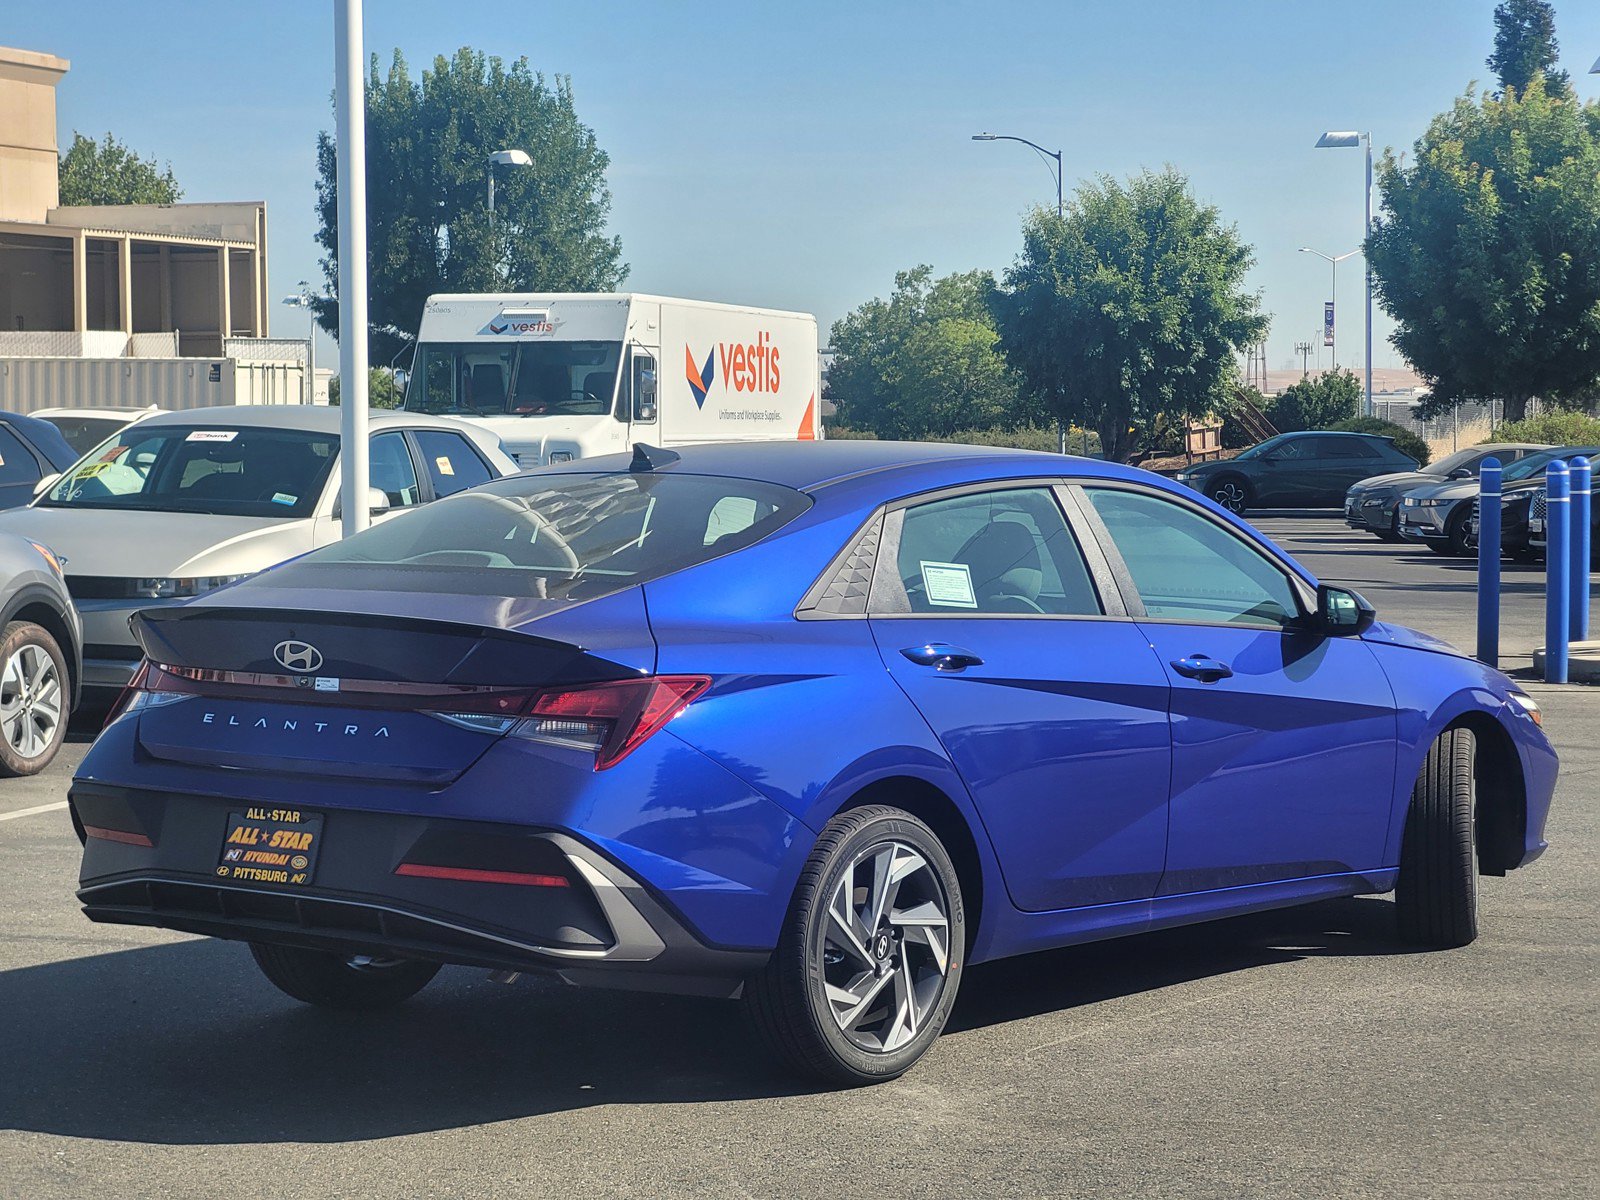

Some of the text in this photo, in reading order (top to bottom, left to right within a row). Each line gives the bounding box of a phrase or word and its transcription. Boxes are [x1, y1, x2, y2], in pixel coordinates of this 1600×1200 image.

[511, 320, 553, 332] vestis
[719, 331, 780, 394] vestis
[718, 409, 736, 420] Uniforms
[202, 713, 390, 738] ELANTRA
[246, 807, 301, 823] ALL STAR
[227, 826, 314, 851] ALL STAR
[242, 850, 291, 866] HYUNDAI
[233, 866, 288, 883] PITTSBURG
